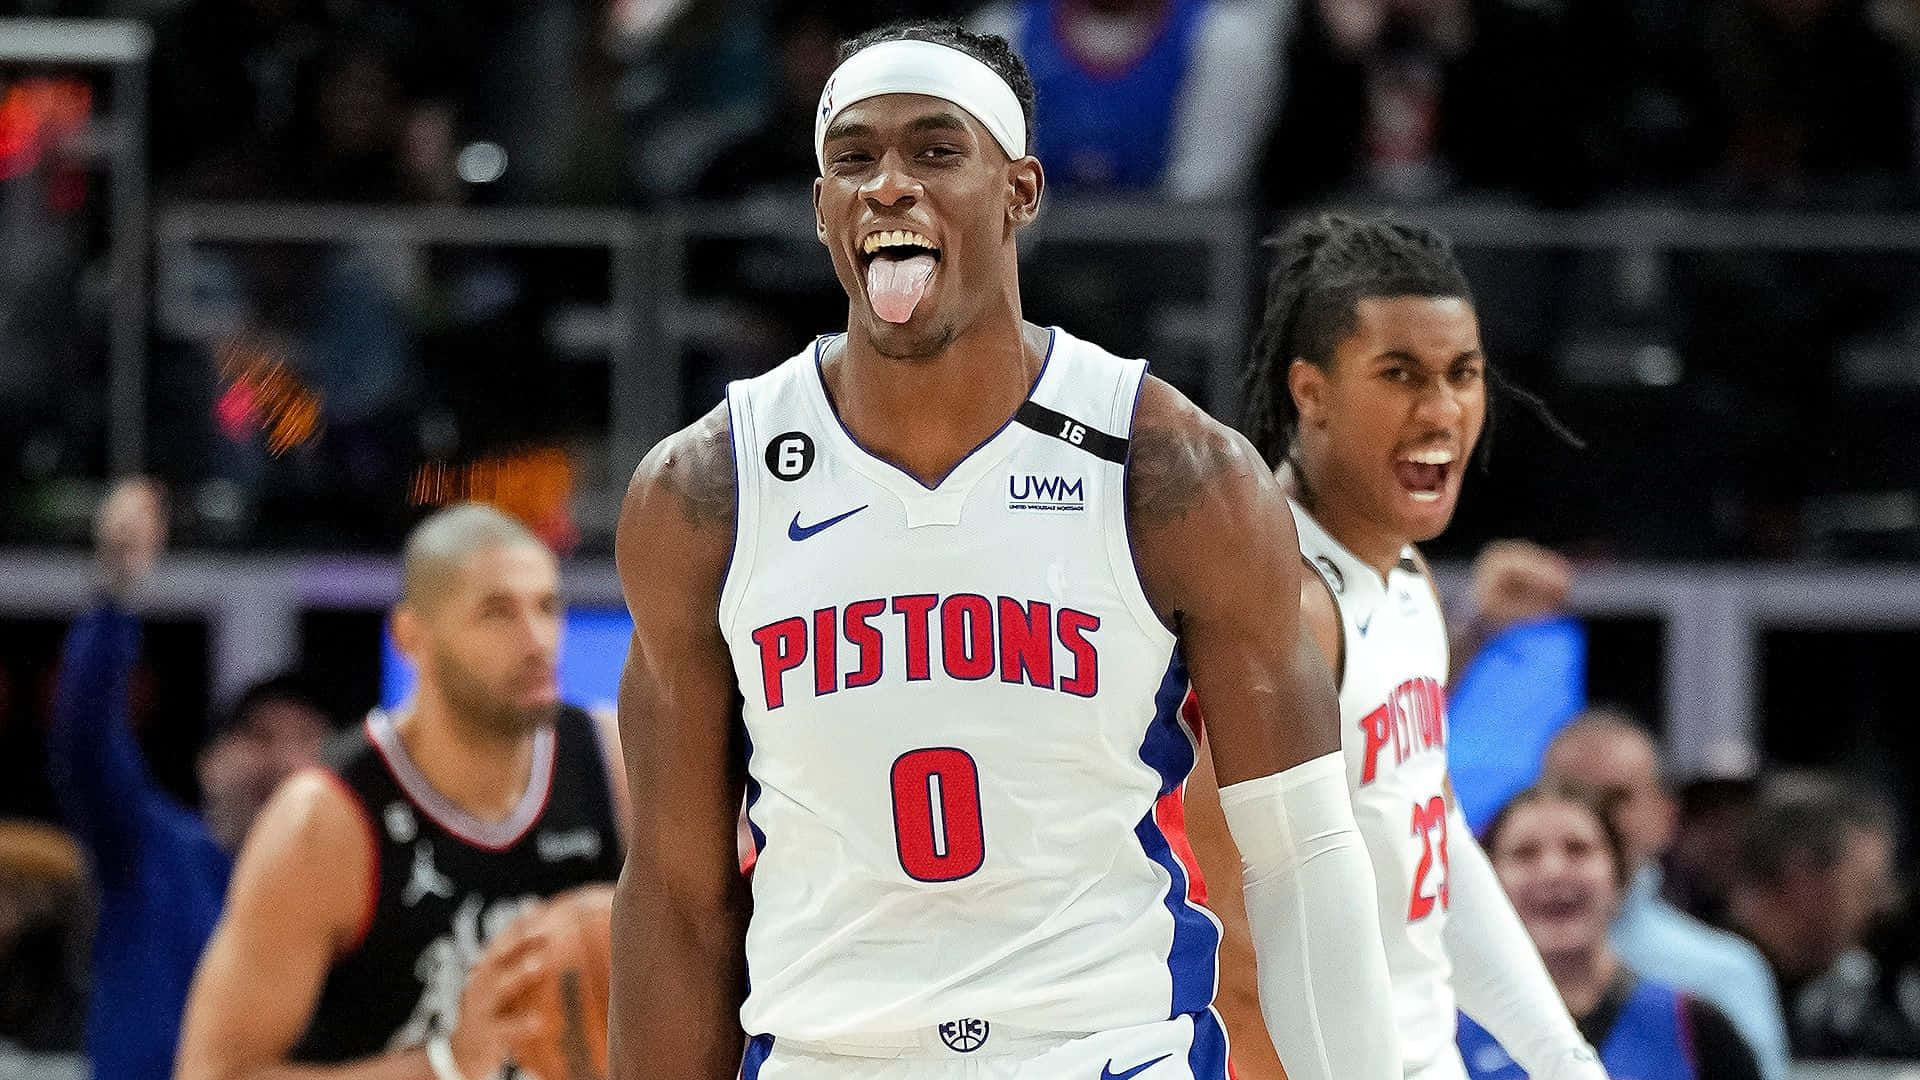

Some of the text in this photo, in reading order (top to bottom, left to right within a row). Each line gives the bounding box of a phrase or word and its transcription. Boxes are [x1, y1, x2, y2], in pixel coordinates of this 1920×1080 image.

[1059, 420, 1086, 445] 16
[778, 438, 804, 475] 6
[1010, 475, 1083, 501] UWM
[752, 593, 1100, 710] PISTONS
[890, 747, 985, 883] 0
